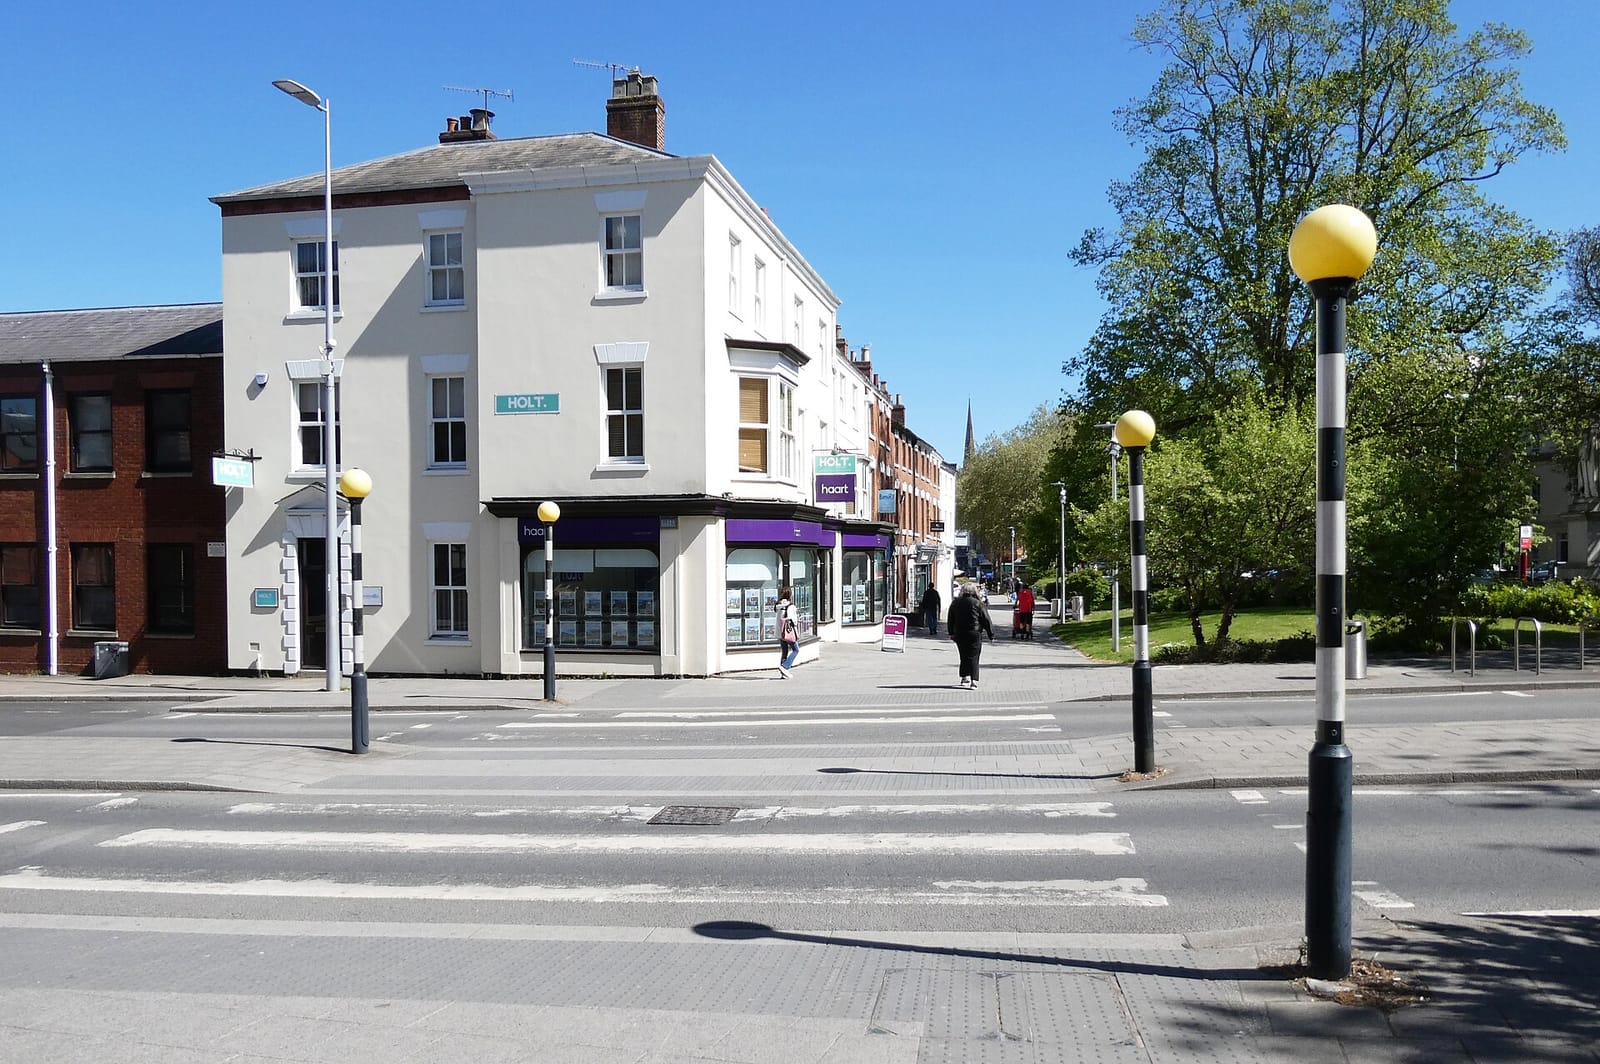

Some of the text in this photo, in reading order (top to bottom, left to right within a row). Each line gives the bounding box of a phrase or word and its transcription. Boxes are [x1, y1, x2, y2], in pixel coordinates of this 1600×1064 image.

[507, 396, 548, 409] HOLT.
[820, 456, 852, 467] HOLT.
[821, 483, 849, 494] haart
[523, 525, 544, 536] haa
